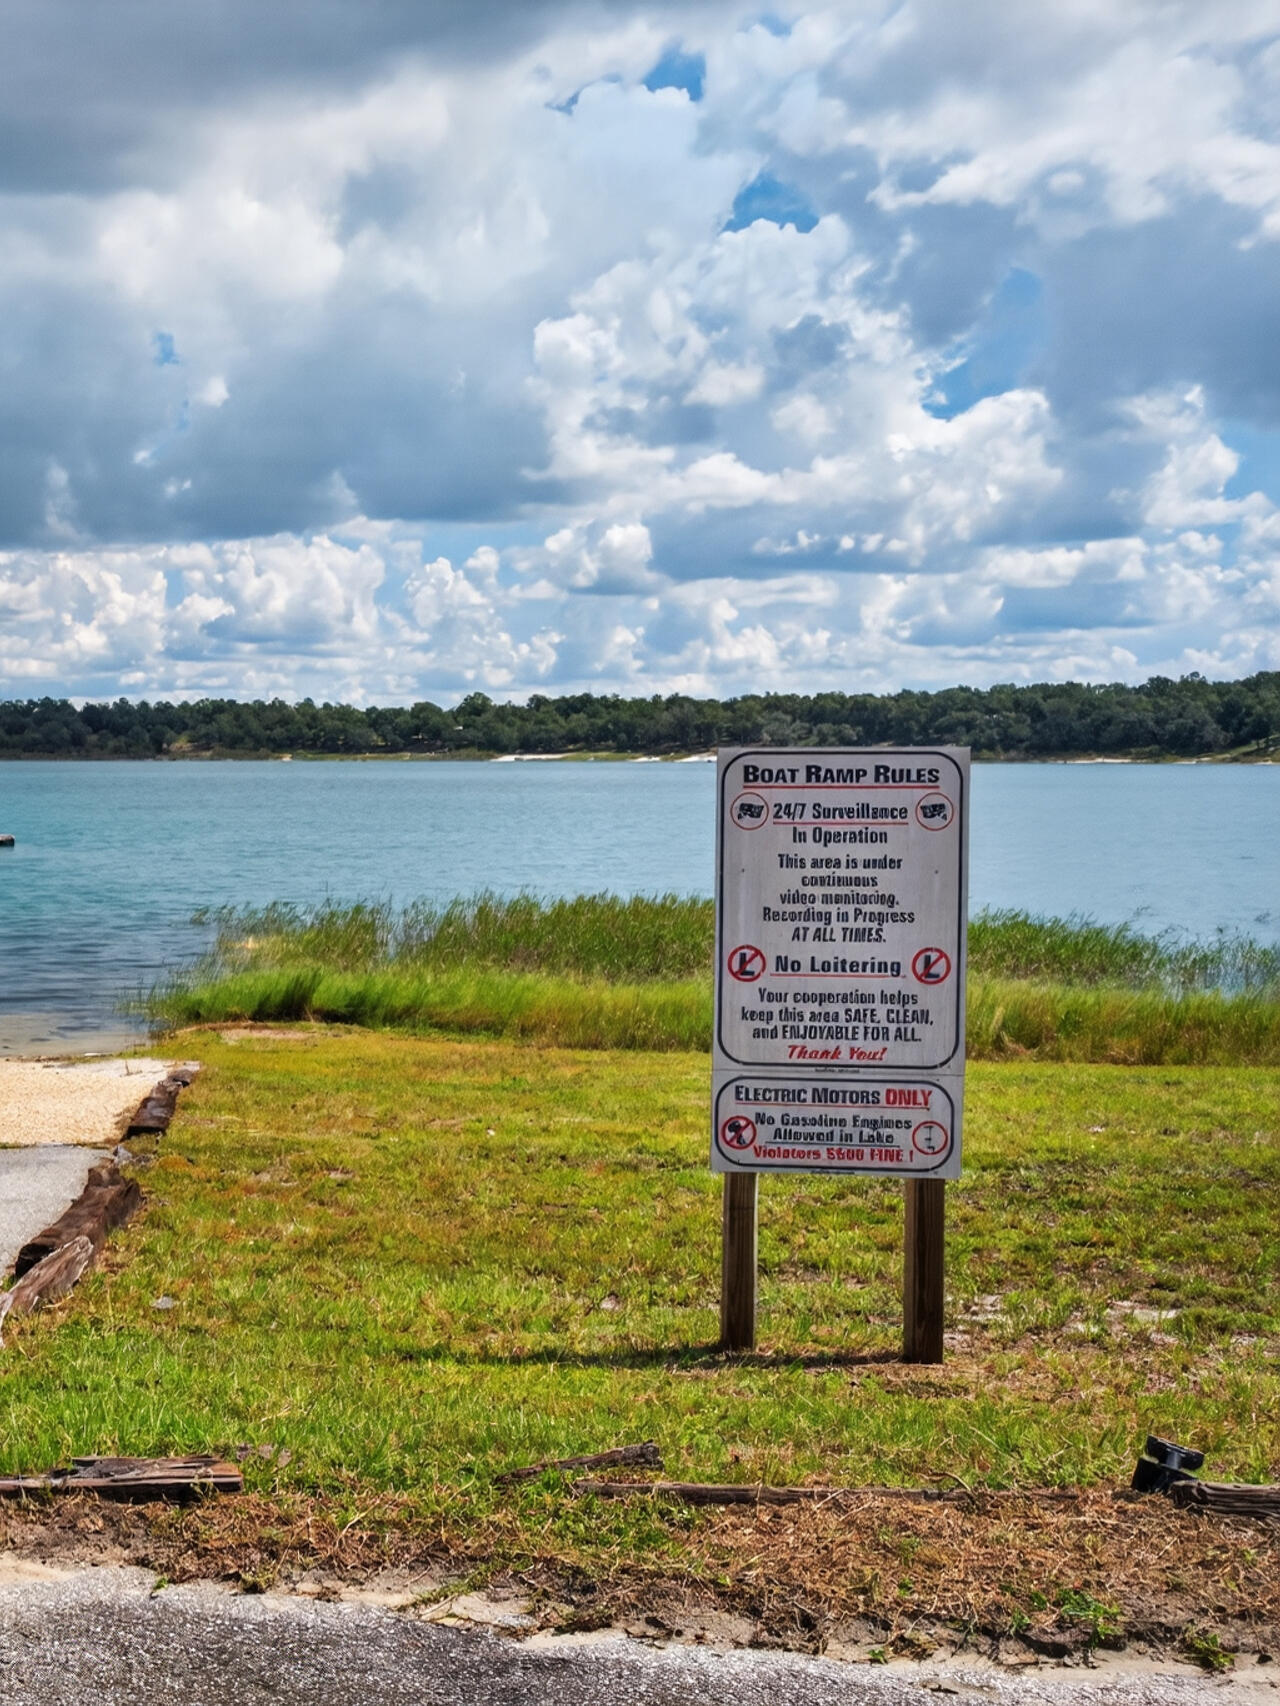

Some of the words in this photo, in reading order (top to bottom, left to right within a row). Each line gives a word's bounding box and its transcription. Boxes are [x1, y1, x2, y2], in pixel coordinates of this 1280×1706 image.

[743, 764, 800, 784] BOAT
[806, 764, 868, 784] RAMP
[874, 765, 941, 784] RULES
[773, 803, 806, 820] 24/7
[812, 803, 908, 820] Surveillance
[793, 827, 807, 843] In
[812, 827, 888, 847] Operation
[778, 854, 807, 869] This
[810, 857, 841, 869] area
[845, 854, 858, 869] is
[863, 854, 903, 869] under
[801, 871, 878, 887] continuous
[780, 889, 816, 905] video
[821, 890, 899, 908] monitoring.
[763, 907, 832, 926] Recording
[836, 907, 849, 923] in
[854, 908, 915, 927] Progress
[791, 927, 809, 942] AT
[813, 927, 837, 942] ALL
[841, 928, 886, 943] TIMES.
[775, 955, 801, 972] No
[810, 956, 901, 977] Loitering
[758, 987, 788, 1003] Your
[793, 989, 877, 1006] cooperation
[880, 990, 918, 1008] helps
[741, 1006, 773, 1024] keep
[778, 1007, 804, 1023] this
[809, 1011, 839, 1023] area
[886, 1009, 934, 1026] CLEAN,
[752, 1025, 778, 1039] and
[782, 1025, 859, 1041] ENJOYABLE
[863, 1026, 889, 1041] FOR
[787, 1045, 842, 1060] Thank
[849, 1047, 888, 1061] You!
[735, 1085, 807, 1104] ELECTRIC
[812, 1087, 880, 1105] MOTORS
[885, 1088, 932, 1107] ONLY
[754, 1112, 775, 1126] No
[781, 1113, 847, 1128] Gasoline
[852, 1115, 912, 1131] Engines
[773, 1127, 834, 1142] Allowed
[839, 1129, 853, 1142] in
[859, 1129, 894, 1144] Lake
[753, 1145, 821, 1160] Violators
